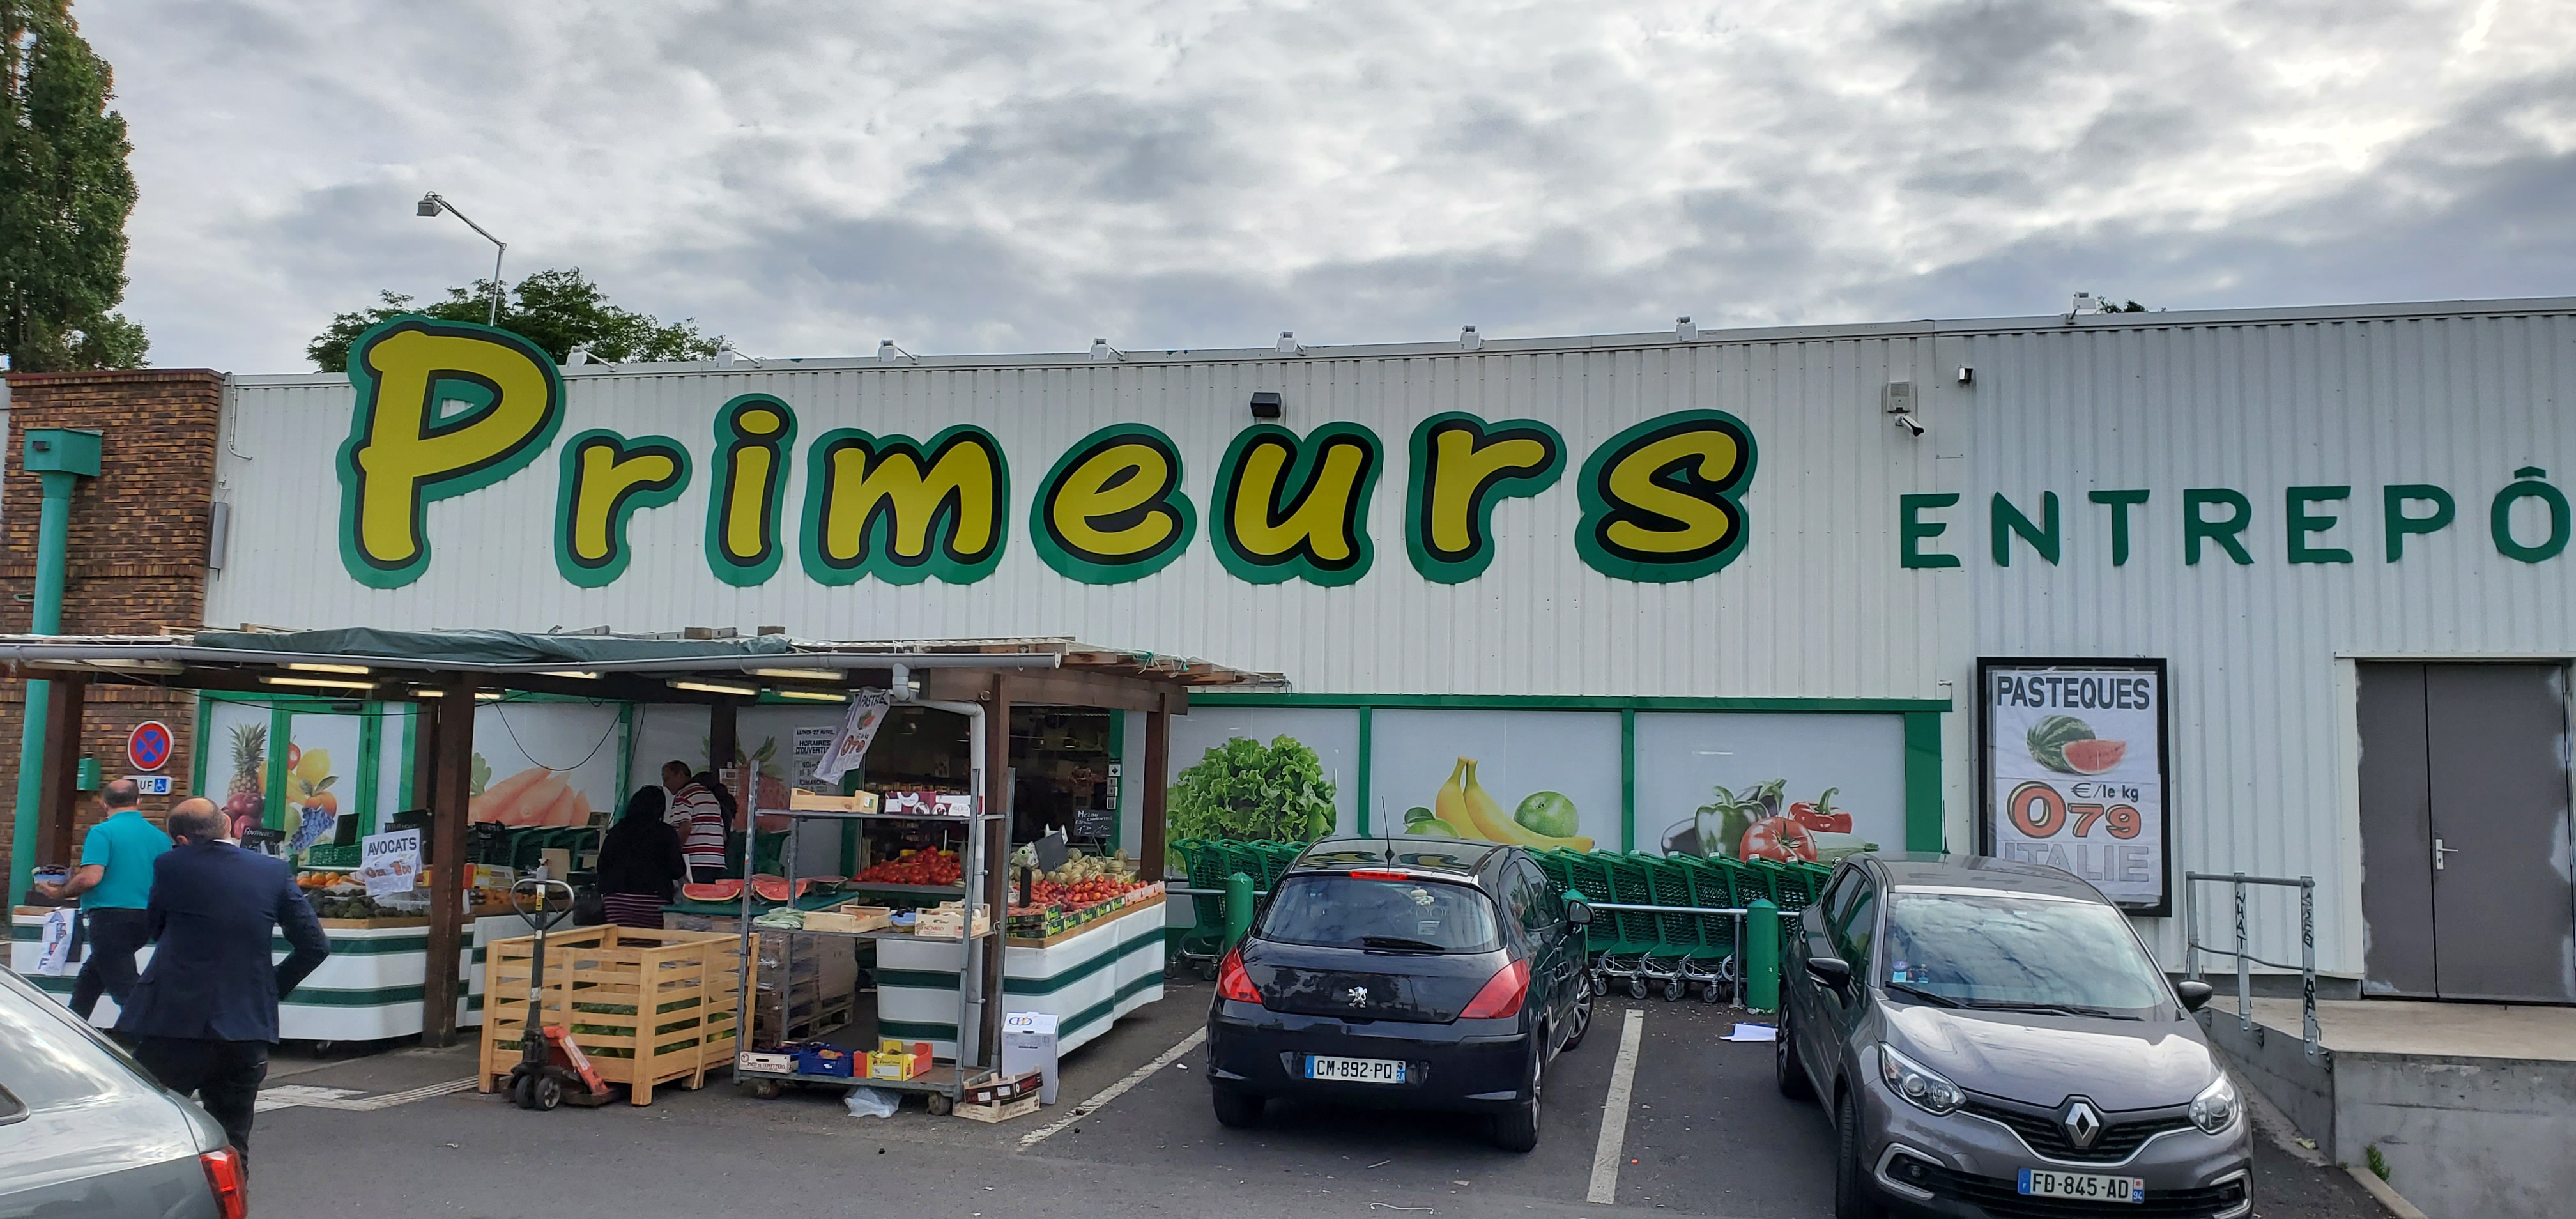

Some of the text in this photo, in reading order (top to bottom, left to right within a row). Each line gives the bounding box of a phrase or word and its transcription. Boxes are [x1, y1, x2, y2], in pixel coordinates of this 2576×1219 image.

[339, 317, 1759, 588] Primeurs
[1997, 675, 2150, 710] PASTEQUES
[795, 746, 831, 755] D'OUVERTU
[140, 780, 153, 790] UF
[2122, 785, 2138, 802] kg
[2007, 780, 2142, 839] 079
[367, 836, 417, 857] AVOCATS
[2237, 891, 2247, 949] WHAT
[1317, 1060, 1392, 1079] CM-892-PQ
[1397, 1072, 1405, 1081] 2A
[2032, 1173, 2129, 1199] FD-845-AD
[2133, 1190, 2143, 1200] 94
